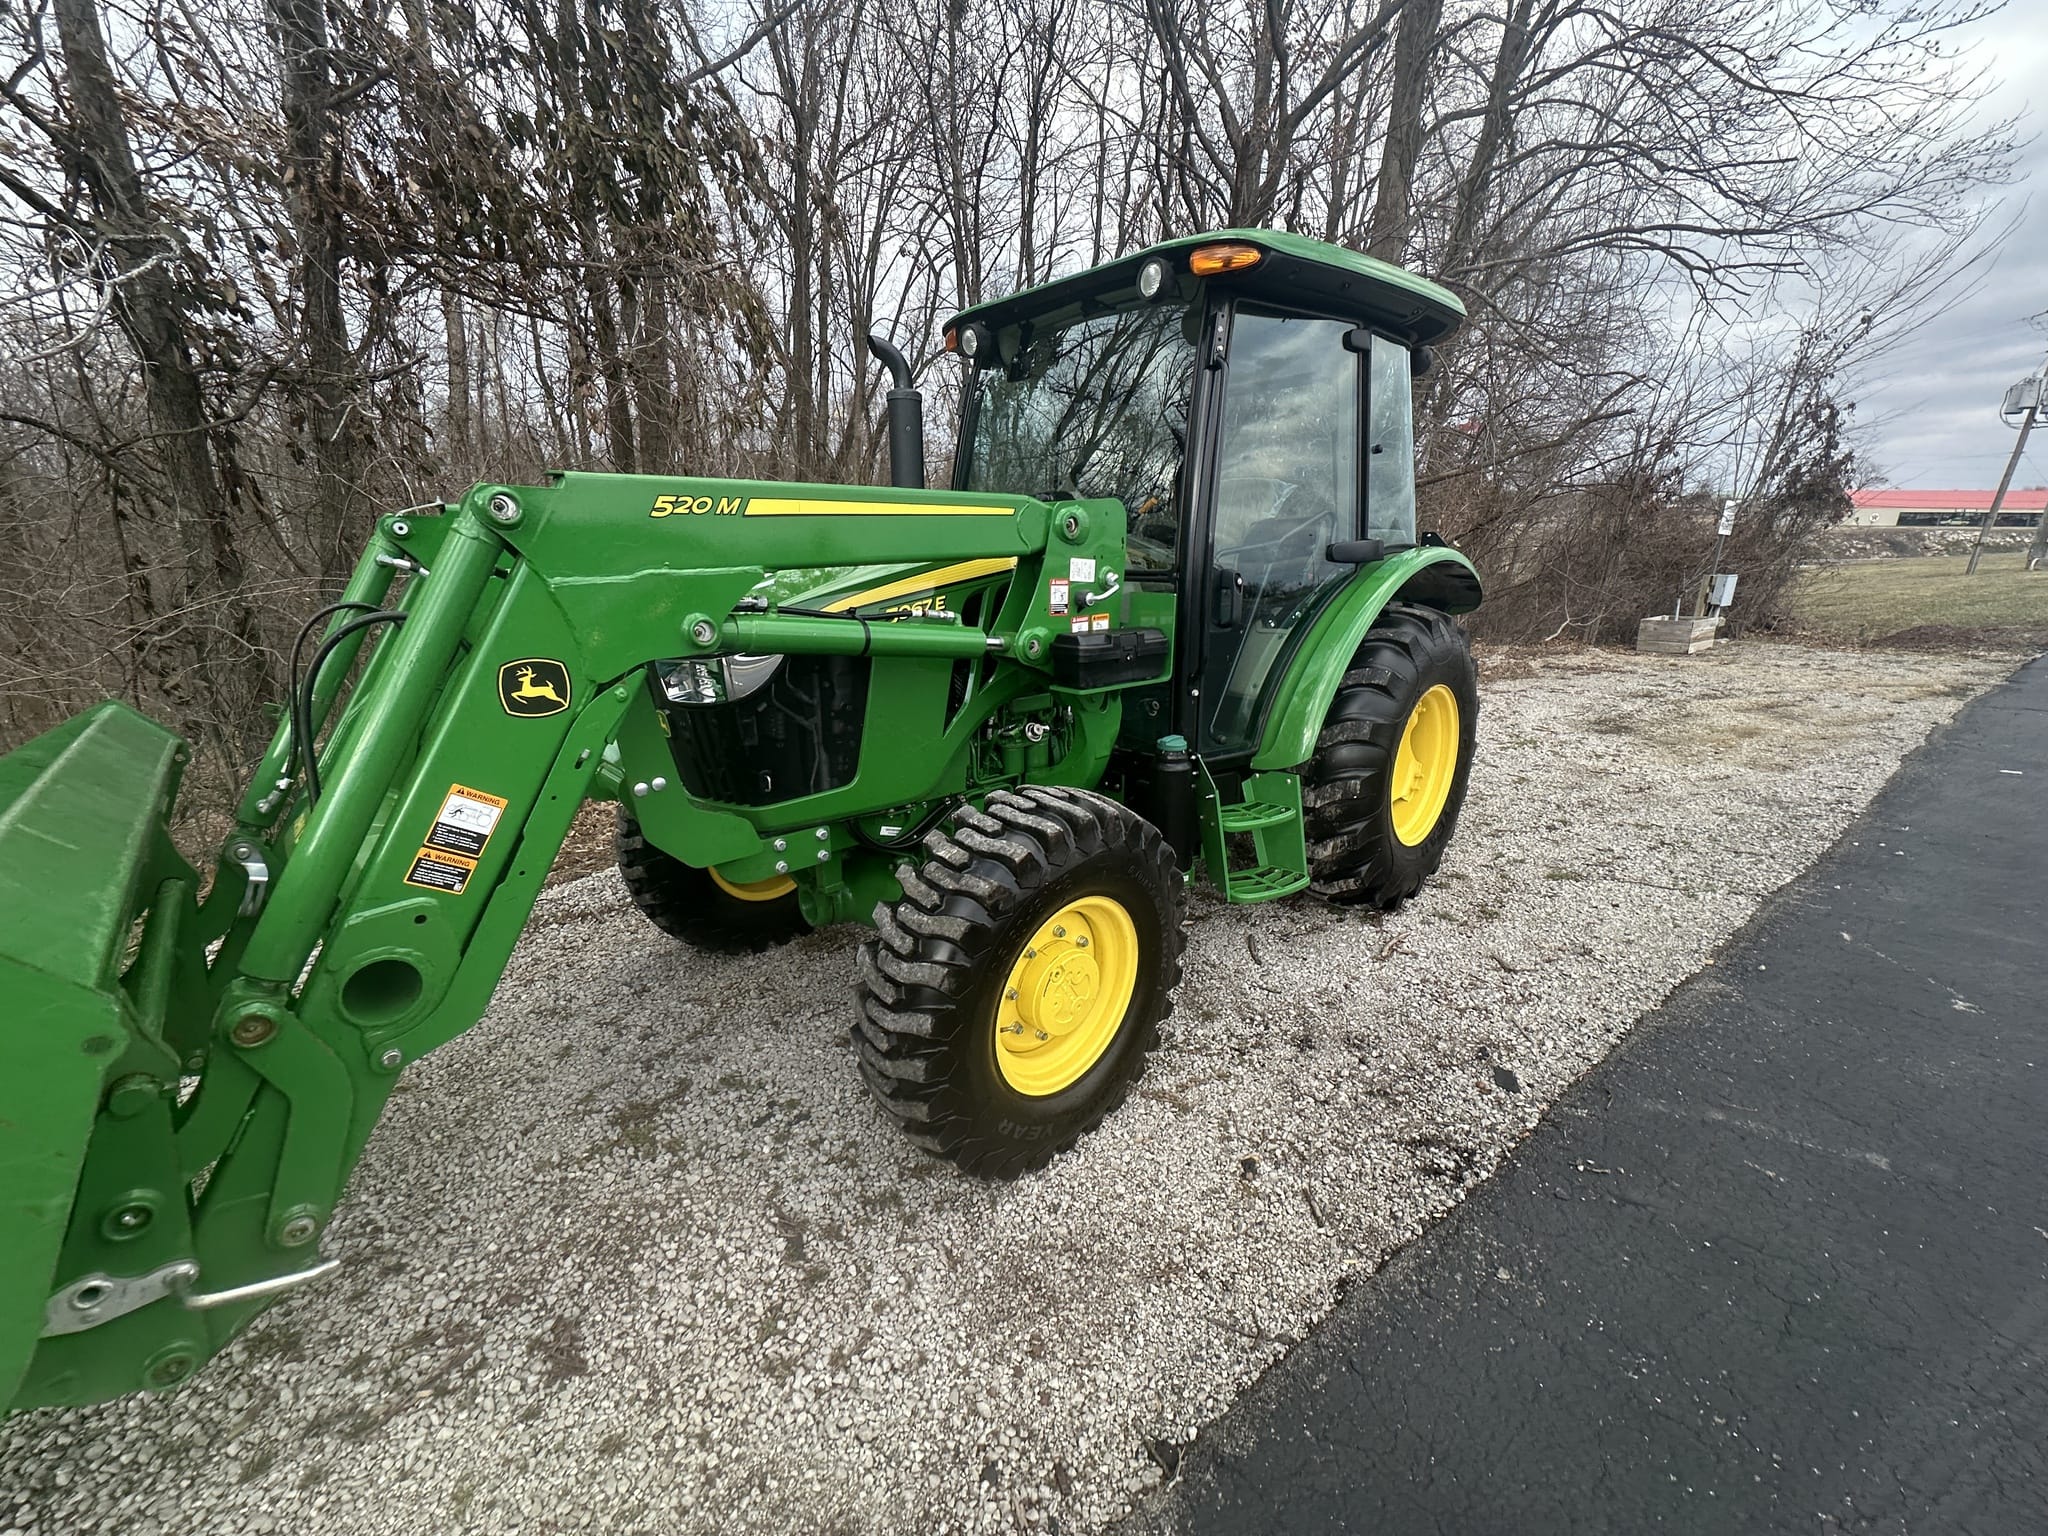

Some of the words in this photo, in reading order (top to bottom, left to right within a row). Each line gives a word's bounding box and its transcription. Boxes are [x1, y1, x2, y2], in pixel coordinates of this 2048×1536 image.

[650, 495, 713, 517] 520
[715, 497, 742, 515] M
[466, 790, 501, 806] WARNING
[434, 853, 471, 867] WARNING
